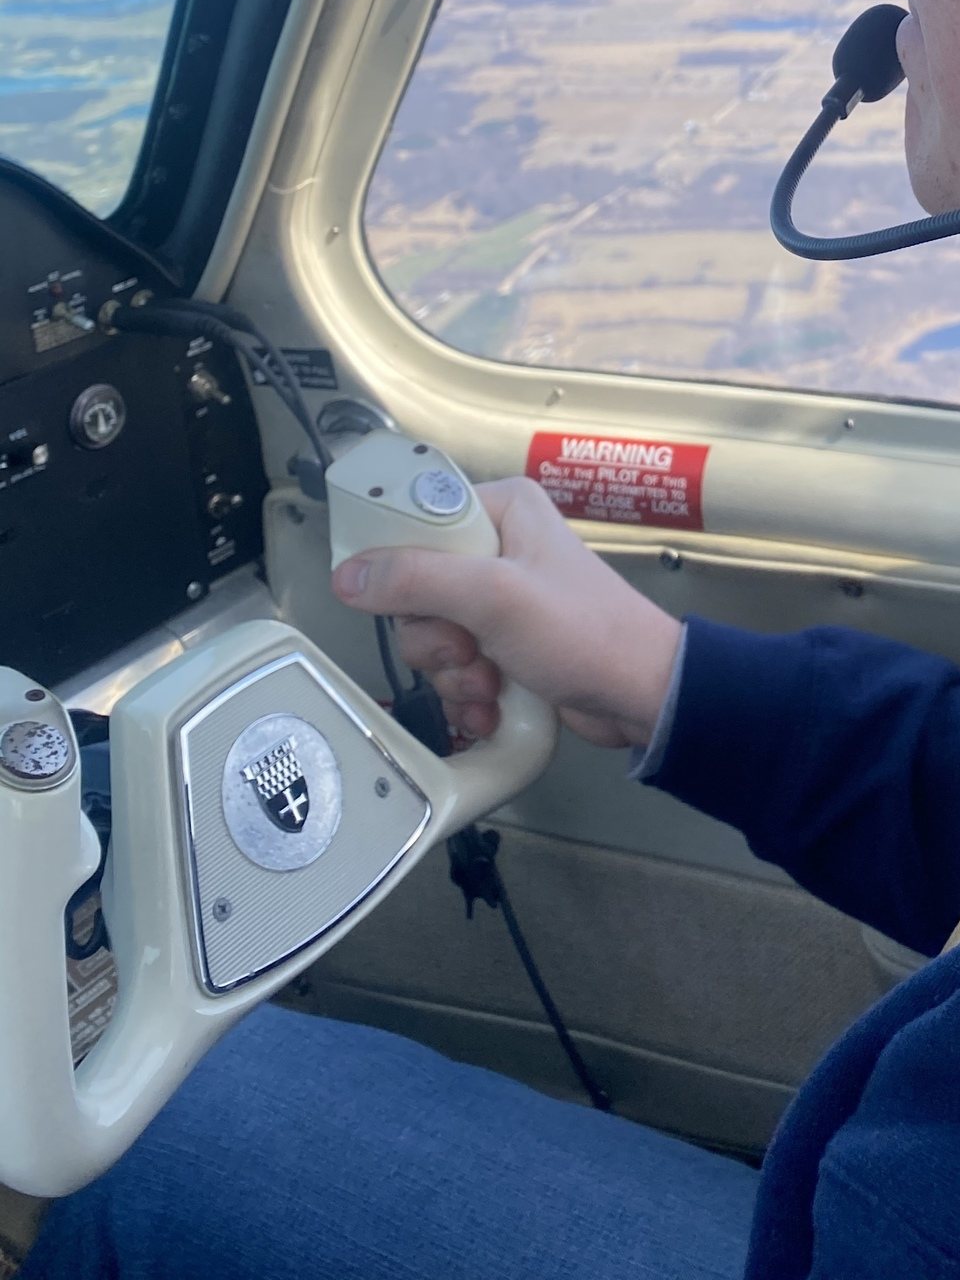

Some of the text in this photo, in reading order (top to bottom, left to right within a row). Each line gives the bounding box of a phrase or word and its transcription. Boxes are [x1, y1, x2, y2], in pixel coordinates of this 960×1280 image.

[560, 436, 673, 468] WARNING
[597, 467, 639, 484] PILOT
[642, 473, 658, 486] OF
[662, 475, 687, 490] THIS
[588, 492, 634, 510] CLOSE
[650, 499, 689, 516] LOCK
